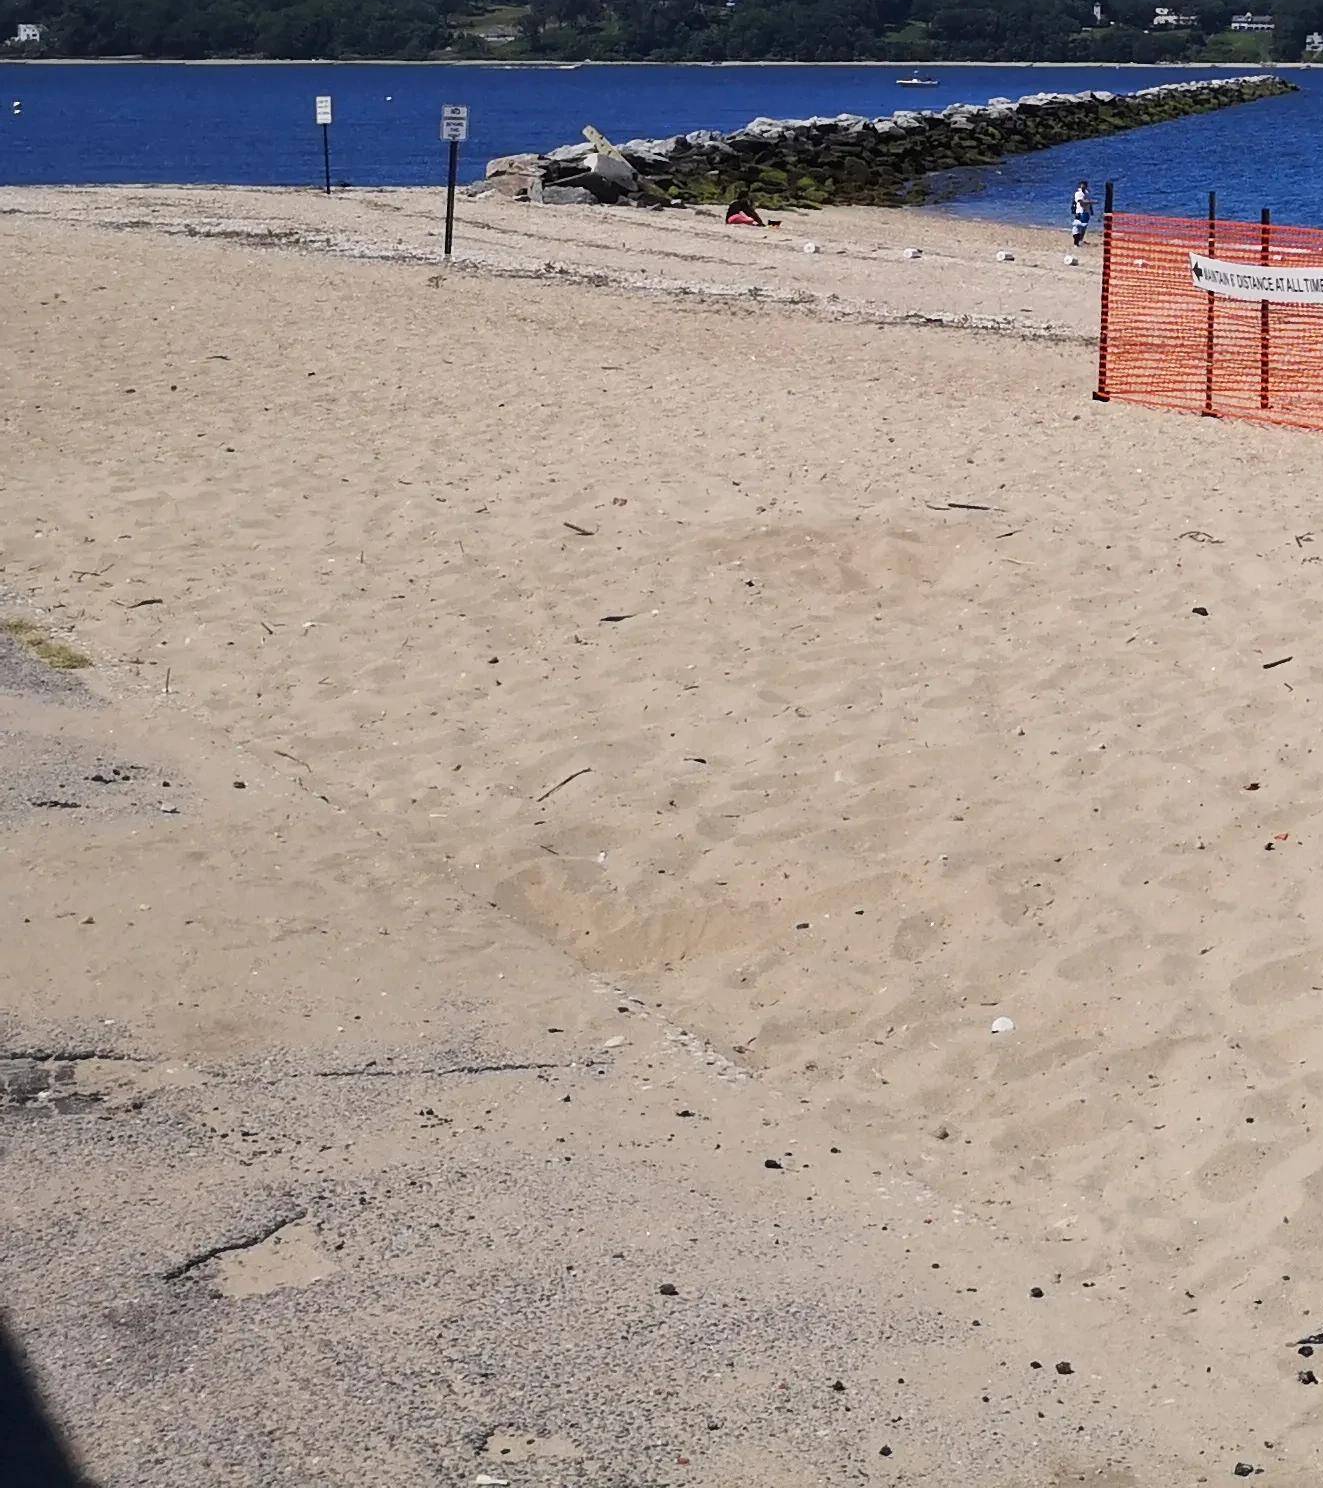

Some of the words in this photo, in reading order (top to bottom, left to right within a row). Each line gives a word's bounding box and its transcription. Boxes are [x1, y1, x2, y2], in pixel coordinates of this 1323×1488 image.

[1237, 274, 1274, 291] DISTANCE
[1276, 278, 1285, 292] AT
[1286, 278, 1303, 292] ALL
